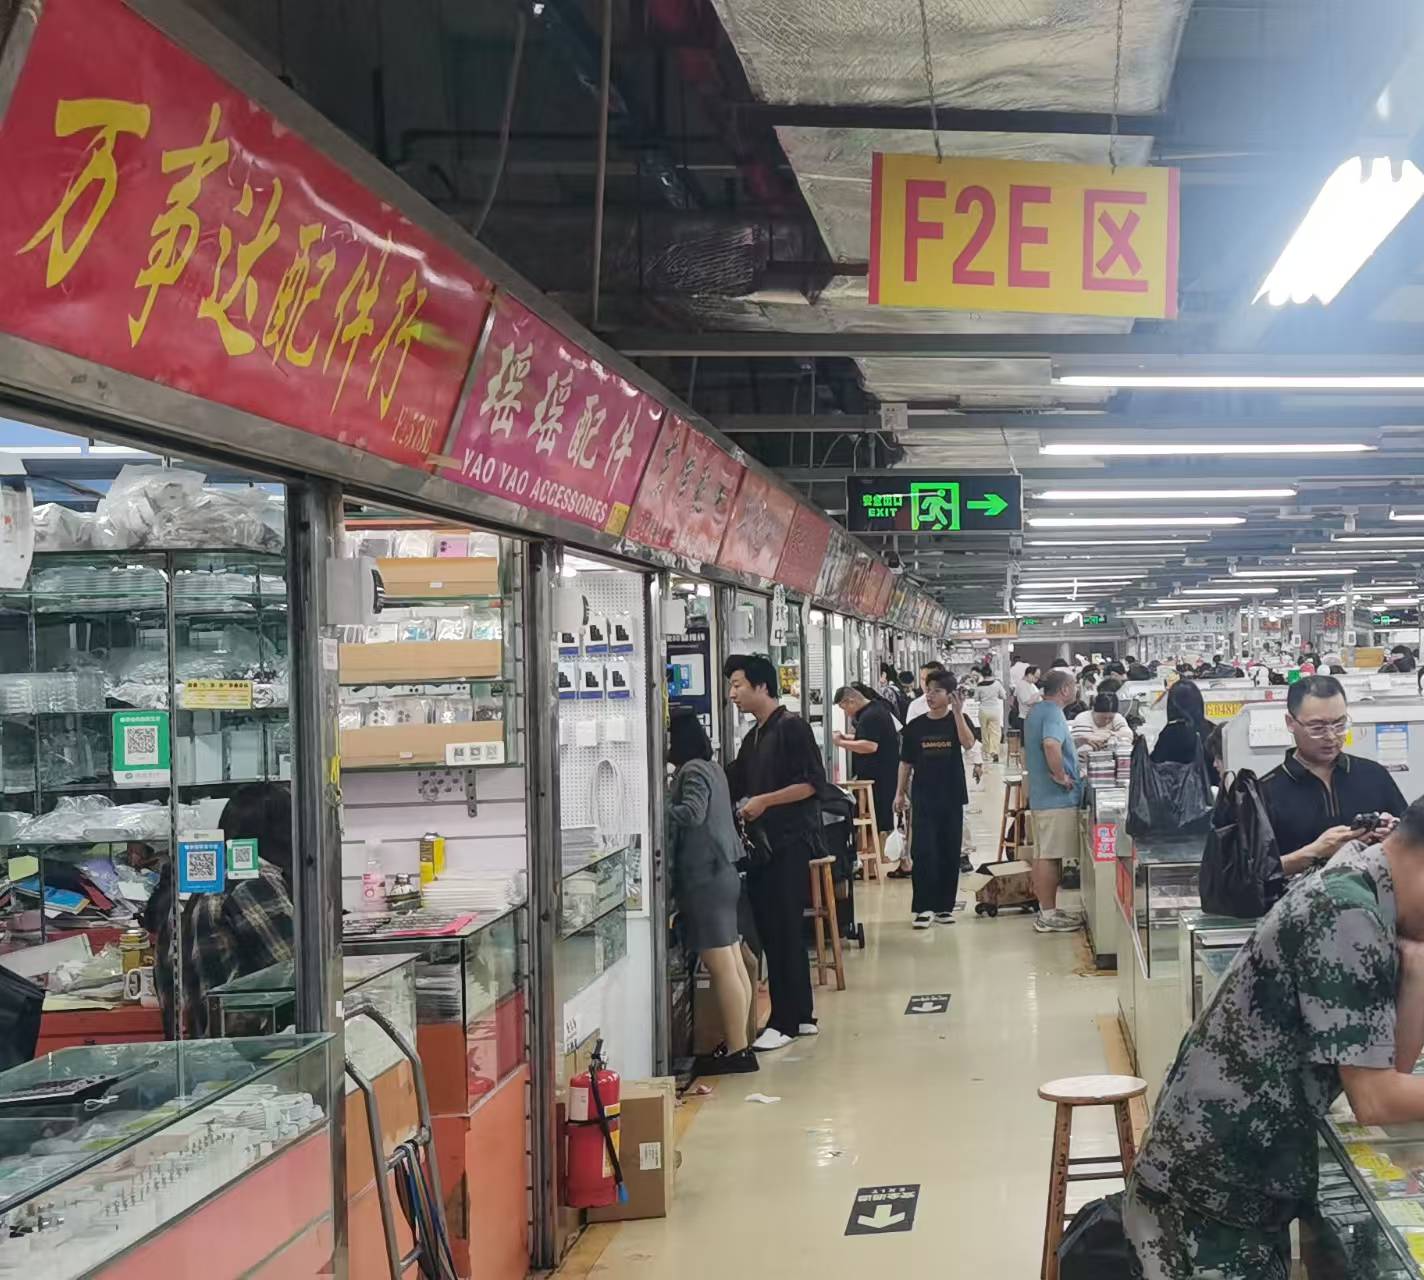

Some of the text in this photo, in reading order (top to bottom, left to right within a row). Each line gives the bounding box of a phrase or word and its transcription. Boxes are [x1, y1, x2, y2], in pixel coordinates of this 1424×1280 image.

[480, 342, 641, 497] 瑶瑶配件
[461, 448, 608, 523] YAO YAO ACCESSORIES
[868, 507, 898, 517] EXIT
